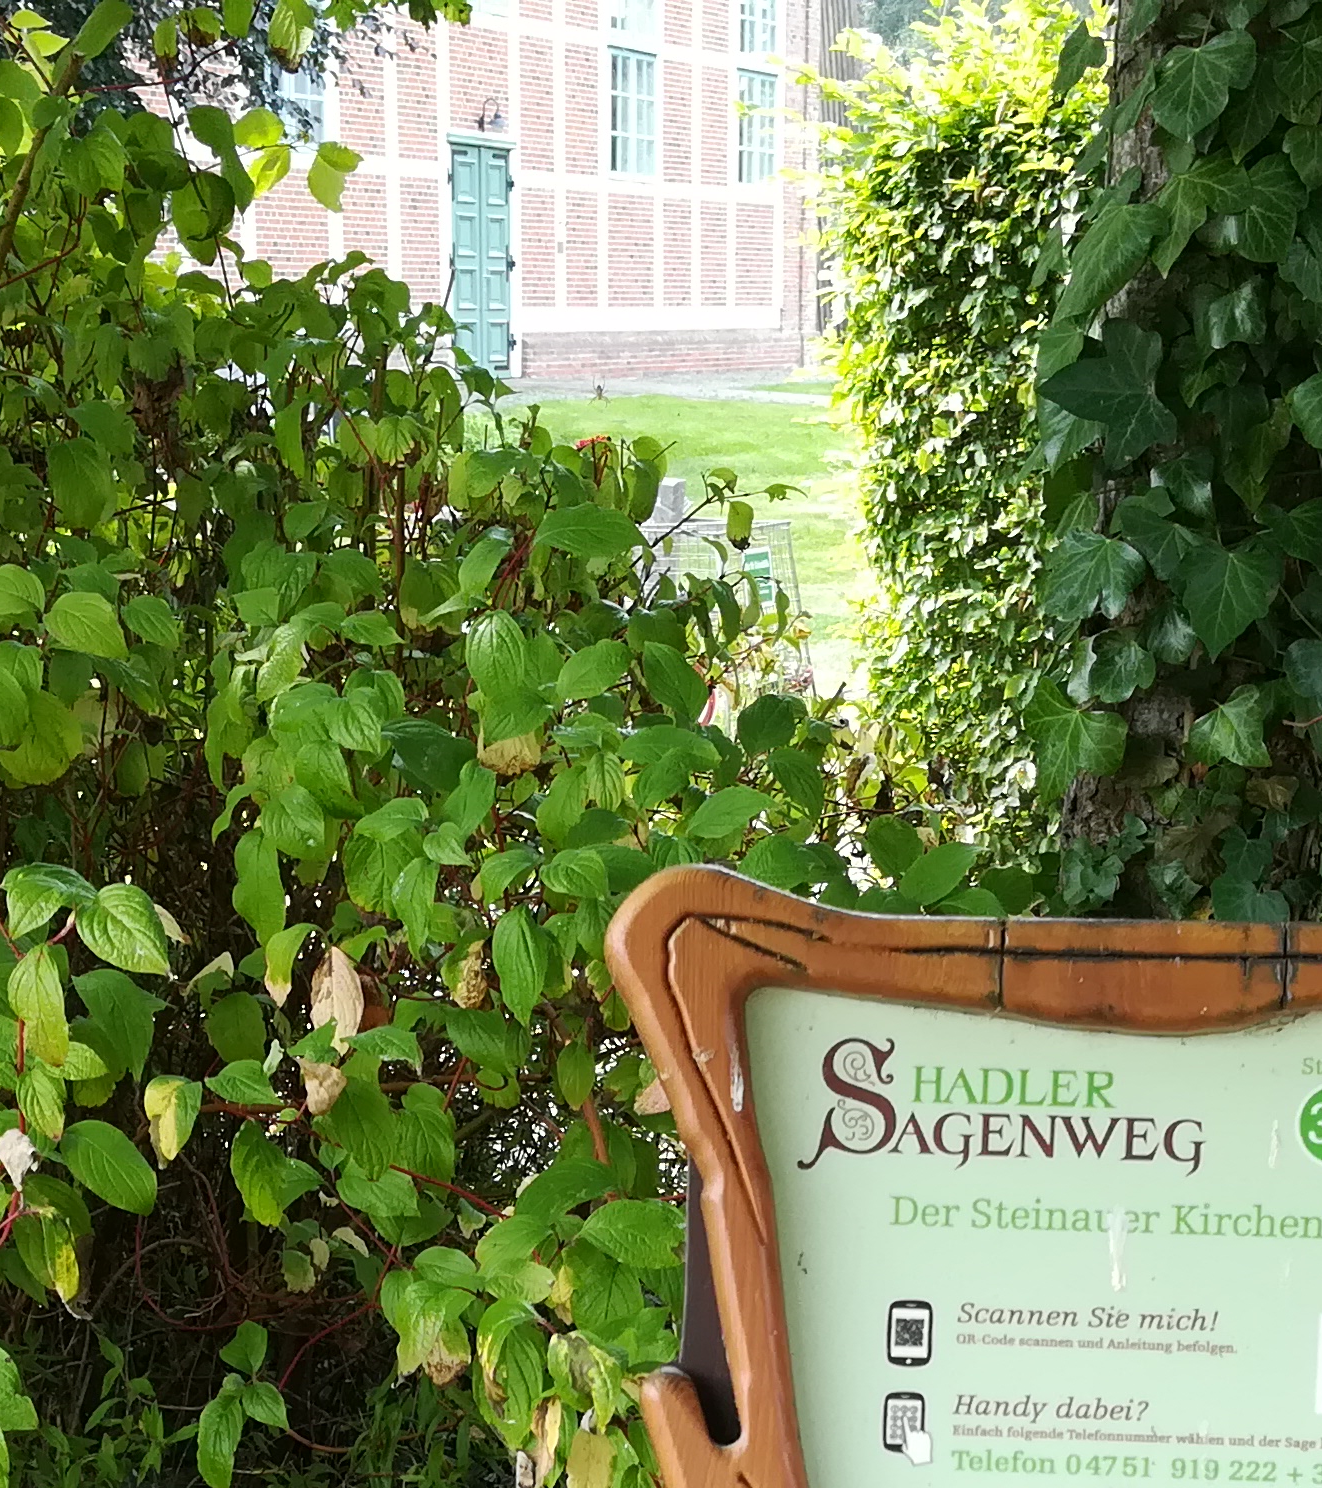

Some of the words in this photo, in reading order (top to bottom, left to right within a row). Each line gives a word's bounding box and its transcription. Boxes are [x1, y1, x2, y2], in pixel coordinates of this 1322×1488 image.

[912, 1066, 1115, 1108] HADLER
[797, 1038, 1206, 1177] SAGENWEG
[889, 1195, 960, 1228] Der
[971, 1198, 1161, 1236] Steinauer
[957, 1302, 1078, 1327] Scannen
[1088, 1305, 1129, 1329] Sie
[1139, 1308, 1219, 1331] mich!
[956, 1333, 1015, 1346] QR-Code
[1019, 1336, 1073, 1348] scannen
[1078, 1337, 1103, 1349] und
[1107, 1338, 1172, 1353] Anleitung
[1177, 1340, 1237, 1355] befolgen.
[952, 1394, 1048, 1423] Handy
[1055, 1396, 1149, 1421] dabei?
[952, 1424, 1003, 1438] Einfach
[1007, 1426, 1064, 1441] folgende
[1067, 1429, 1172, 1443] Telefonnummer
[1228, 1435, 1254, 1447] und
[1258, 1436, 1281, 1448] der
[1284, 1437, 1316, 1451] Sage
[951, 1449, 1056, 1474] Telefon
[1065, 1453, 1152, 1478] 04751
[1171, 1457, 1219, 1480] 919
[1228, 1460, 1277, 1482] 222
